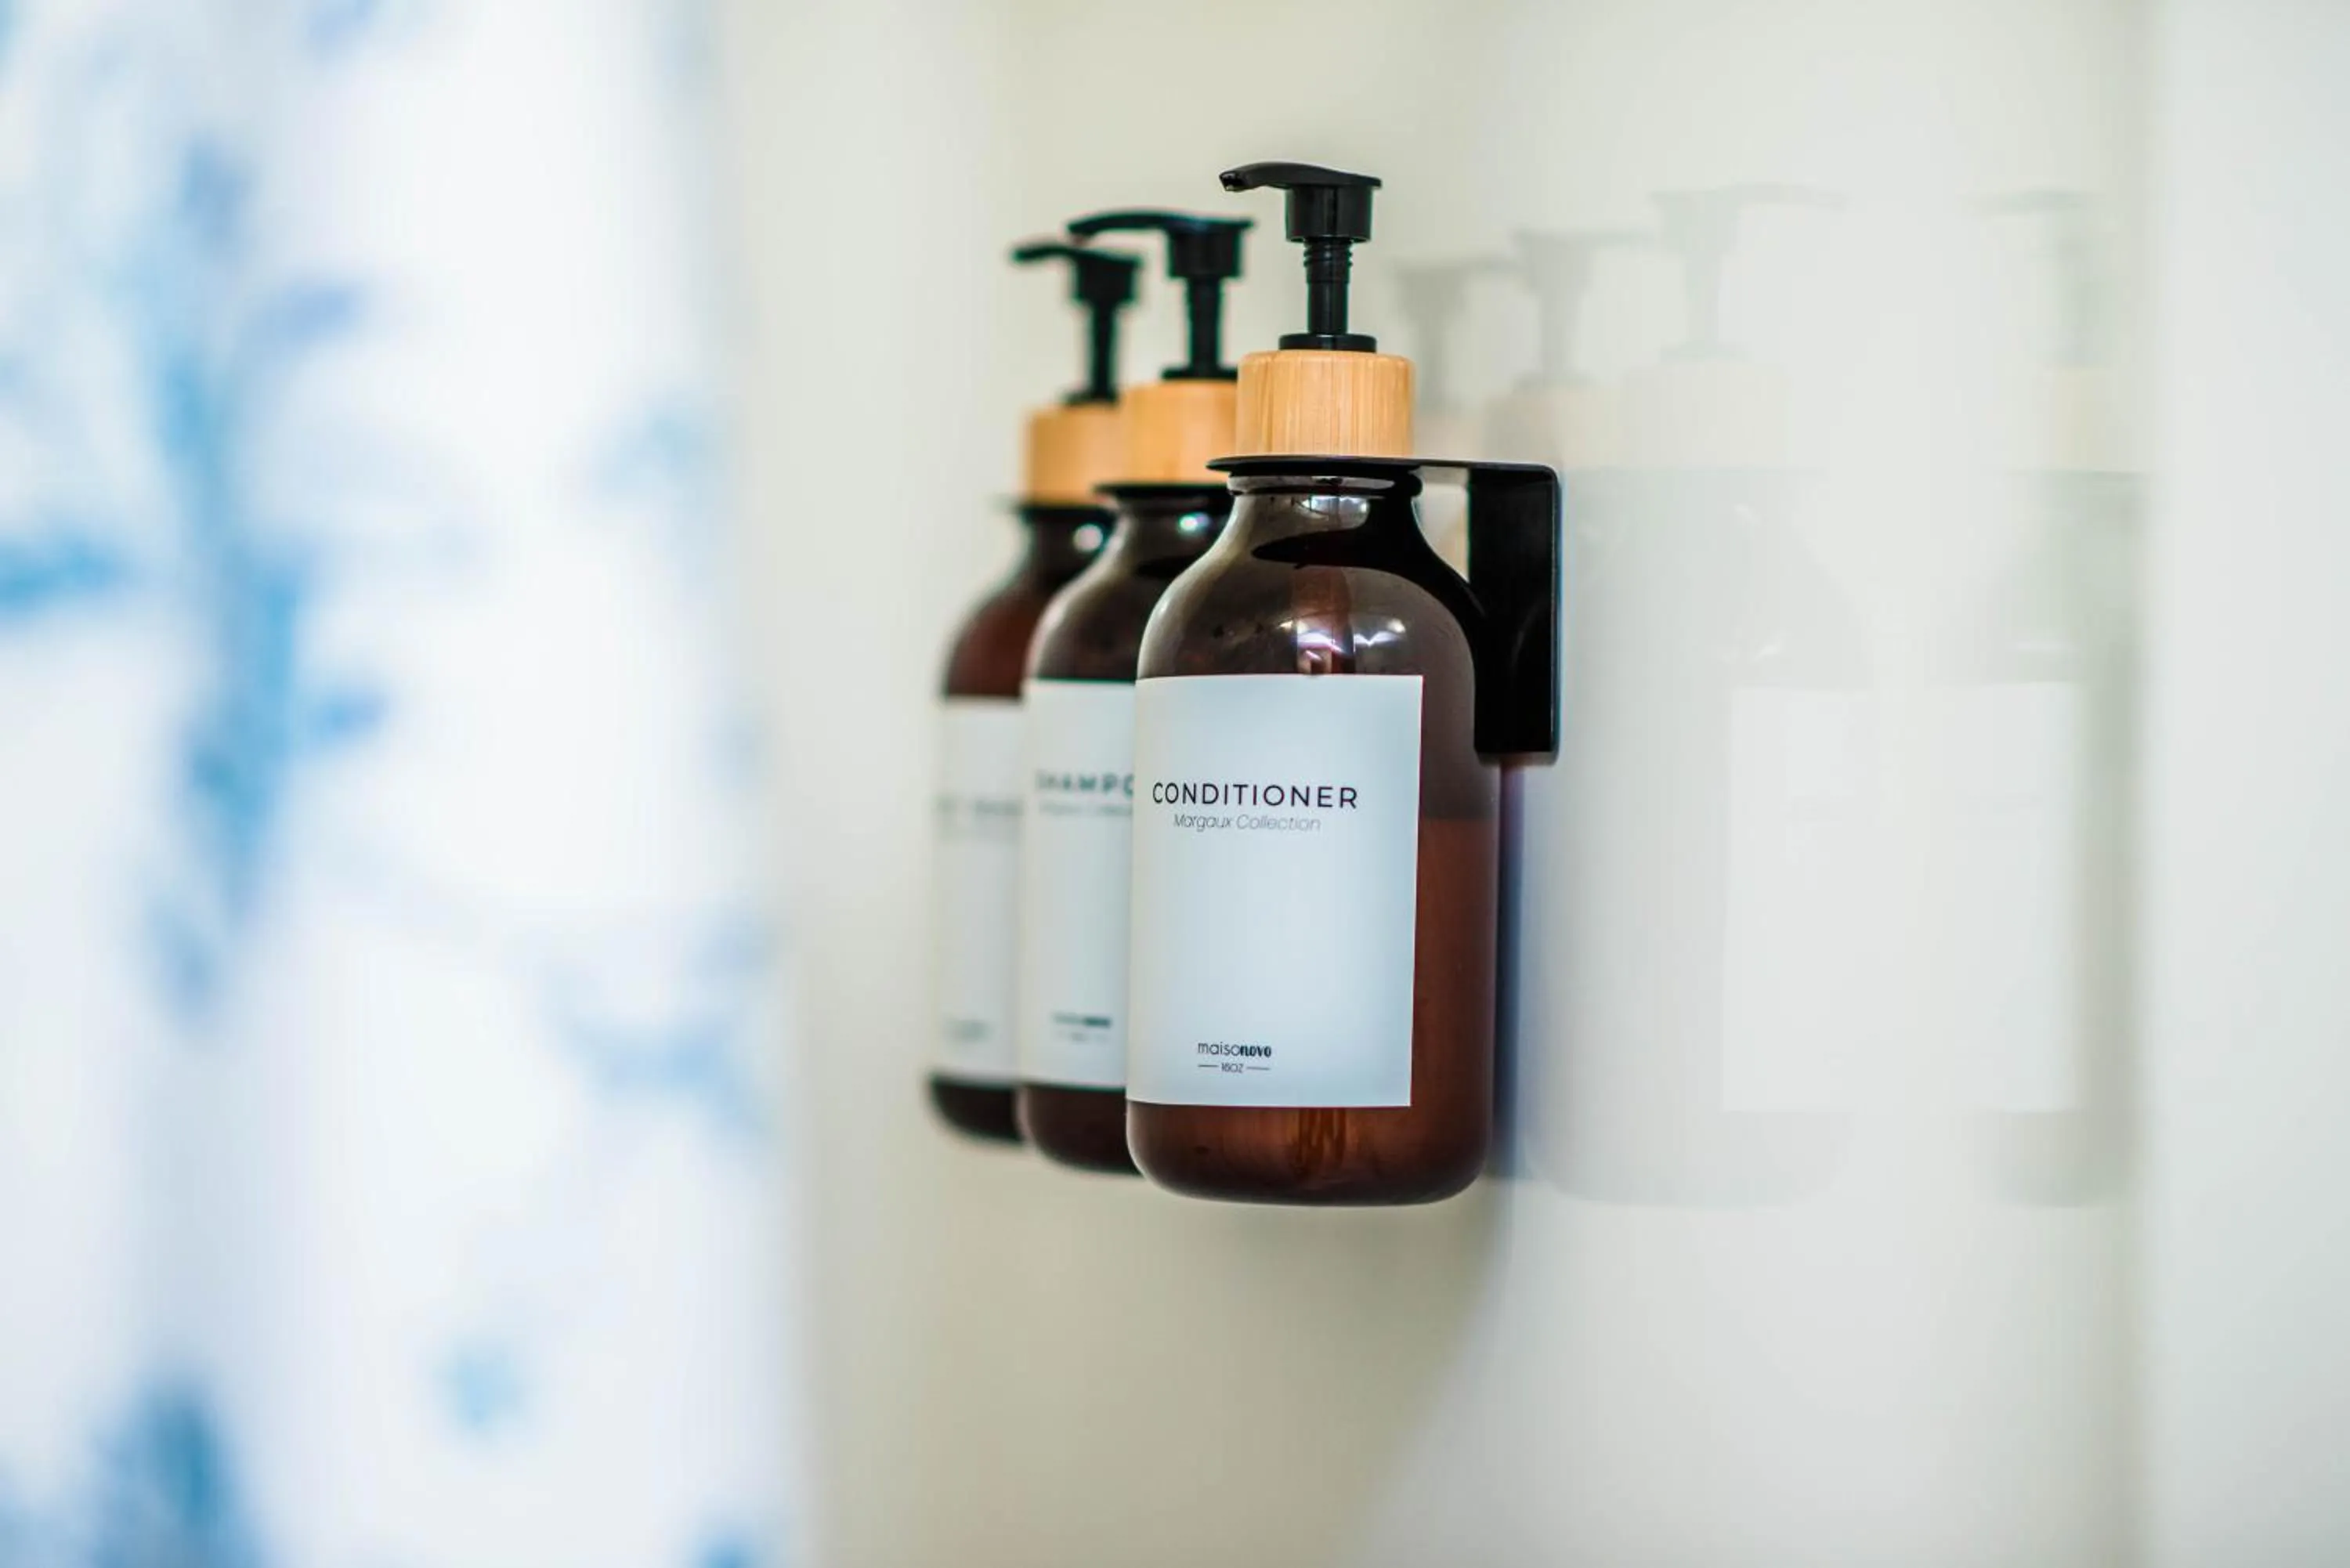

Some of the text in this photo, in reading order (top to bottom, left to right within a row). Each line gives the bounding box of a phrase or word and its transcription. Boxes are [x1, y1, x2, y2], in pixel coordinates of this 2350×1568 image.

[1152, 782, 1358, 809] CONDITIONER
[1173, 813, 1321, 833] Margaux Collection
[1198, 1041, 1271, 1057] maisonovo
